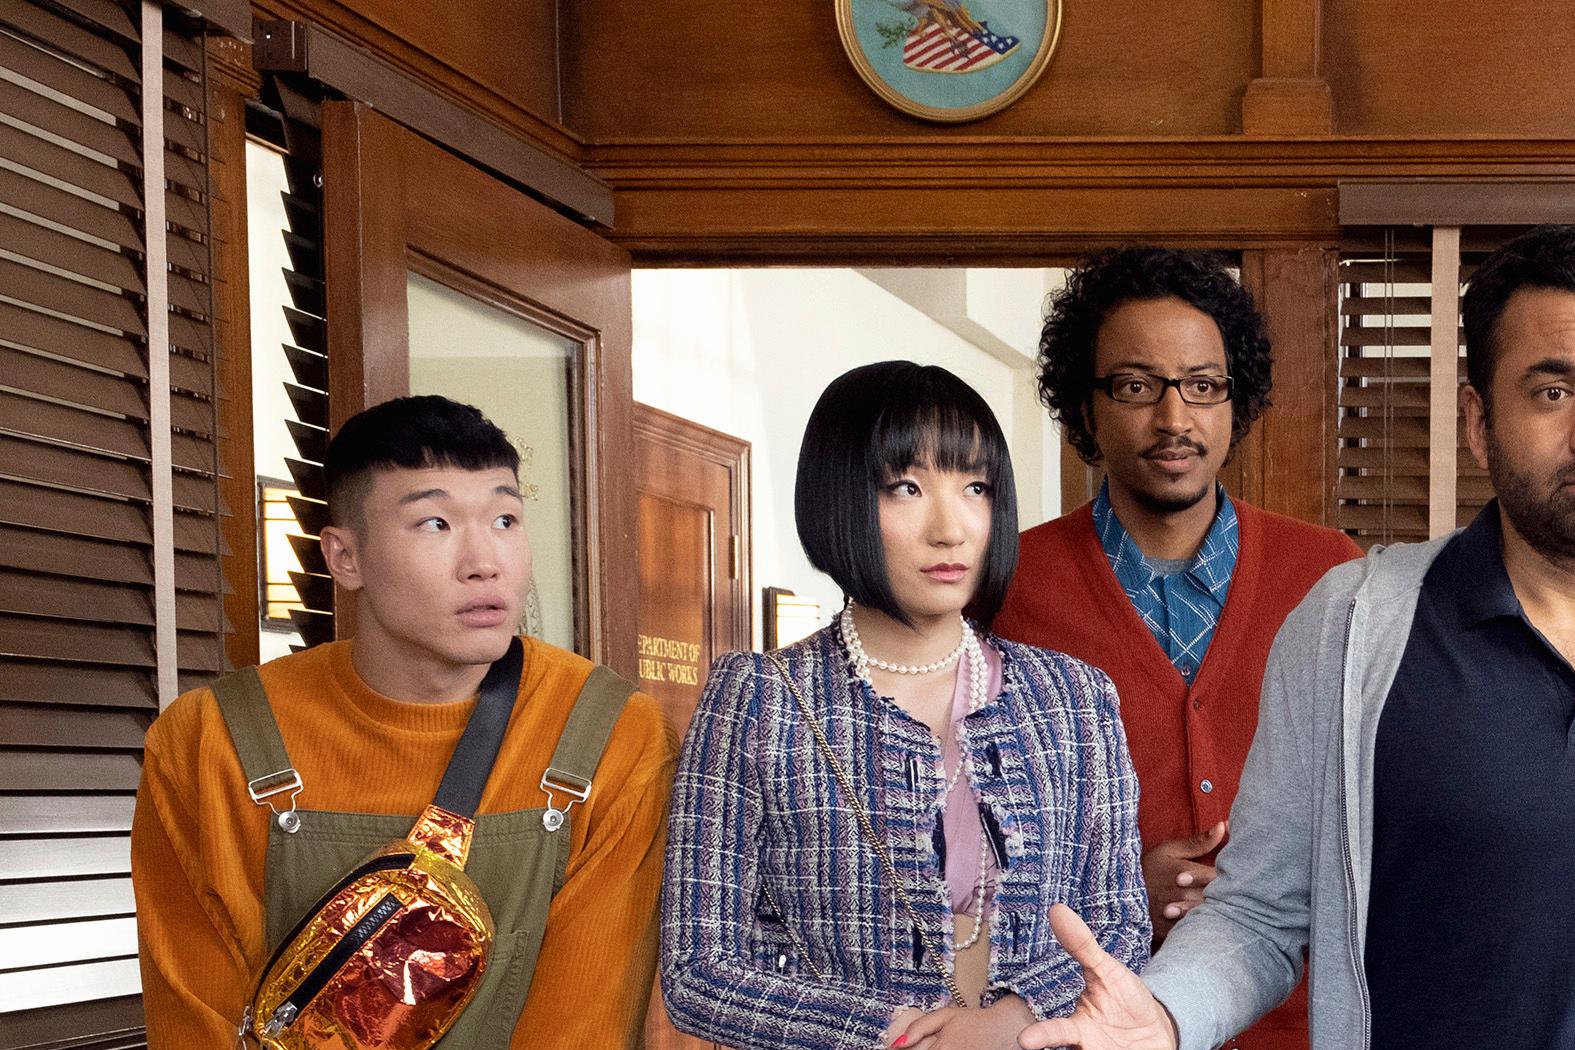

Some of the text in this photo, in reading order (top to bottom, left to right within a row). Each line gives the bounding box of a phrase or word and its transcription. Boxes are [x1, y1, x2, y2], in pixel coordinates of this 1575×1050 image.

[638, 634, 700, 663] EPARTMENT OF
[639, 659, 698, 686] UBLIC WORKS
